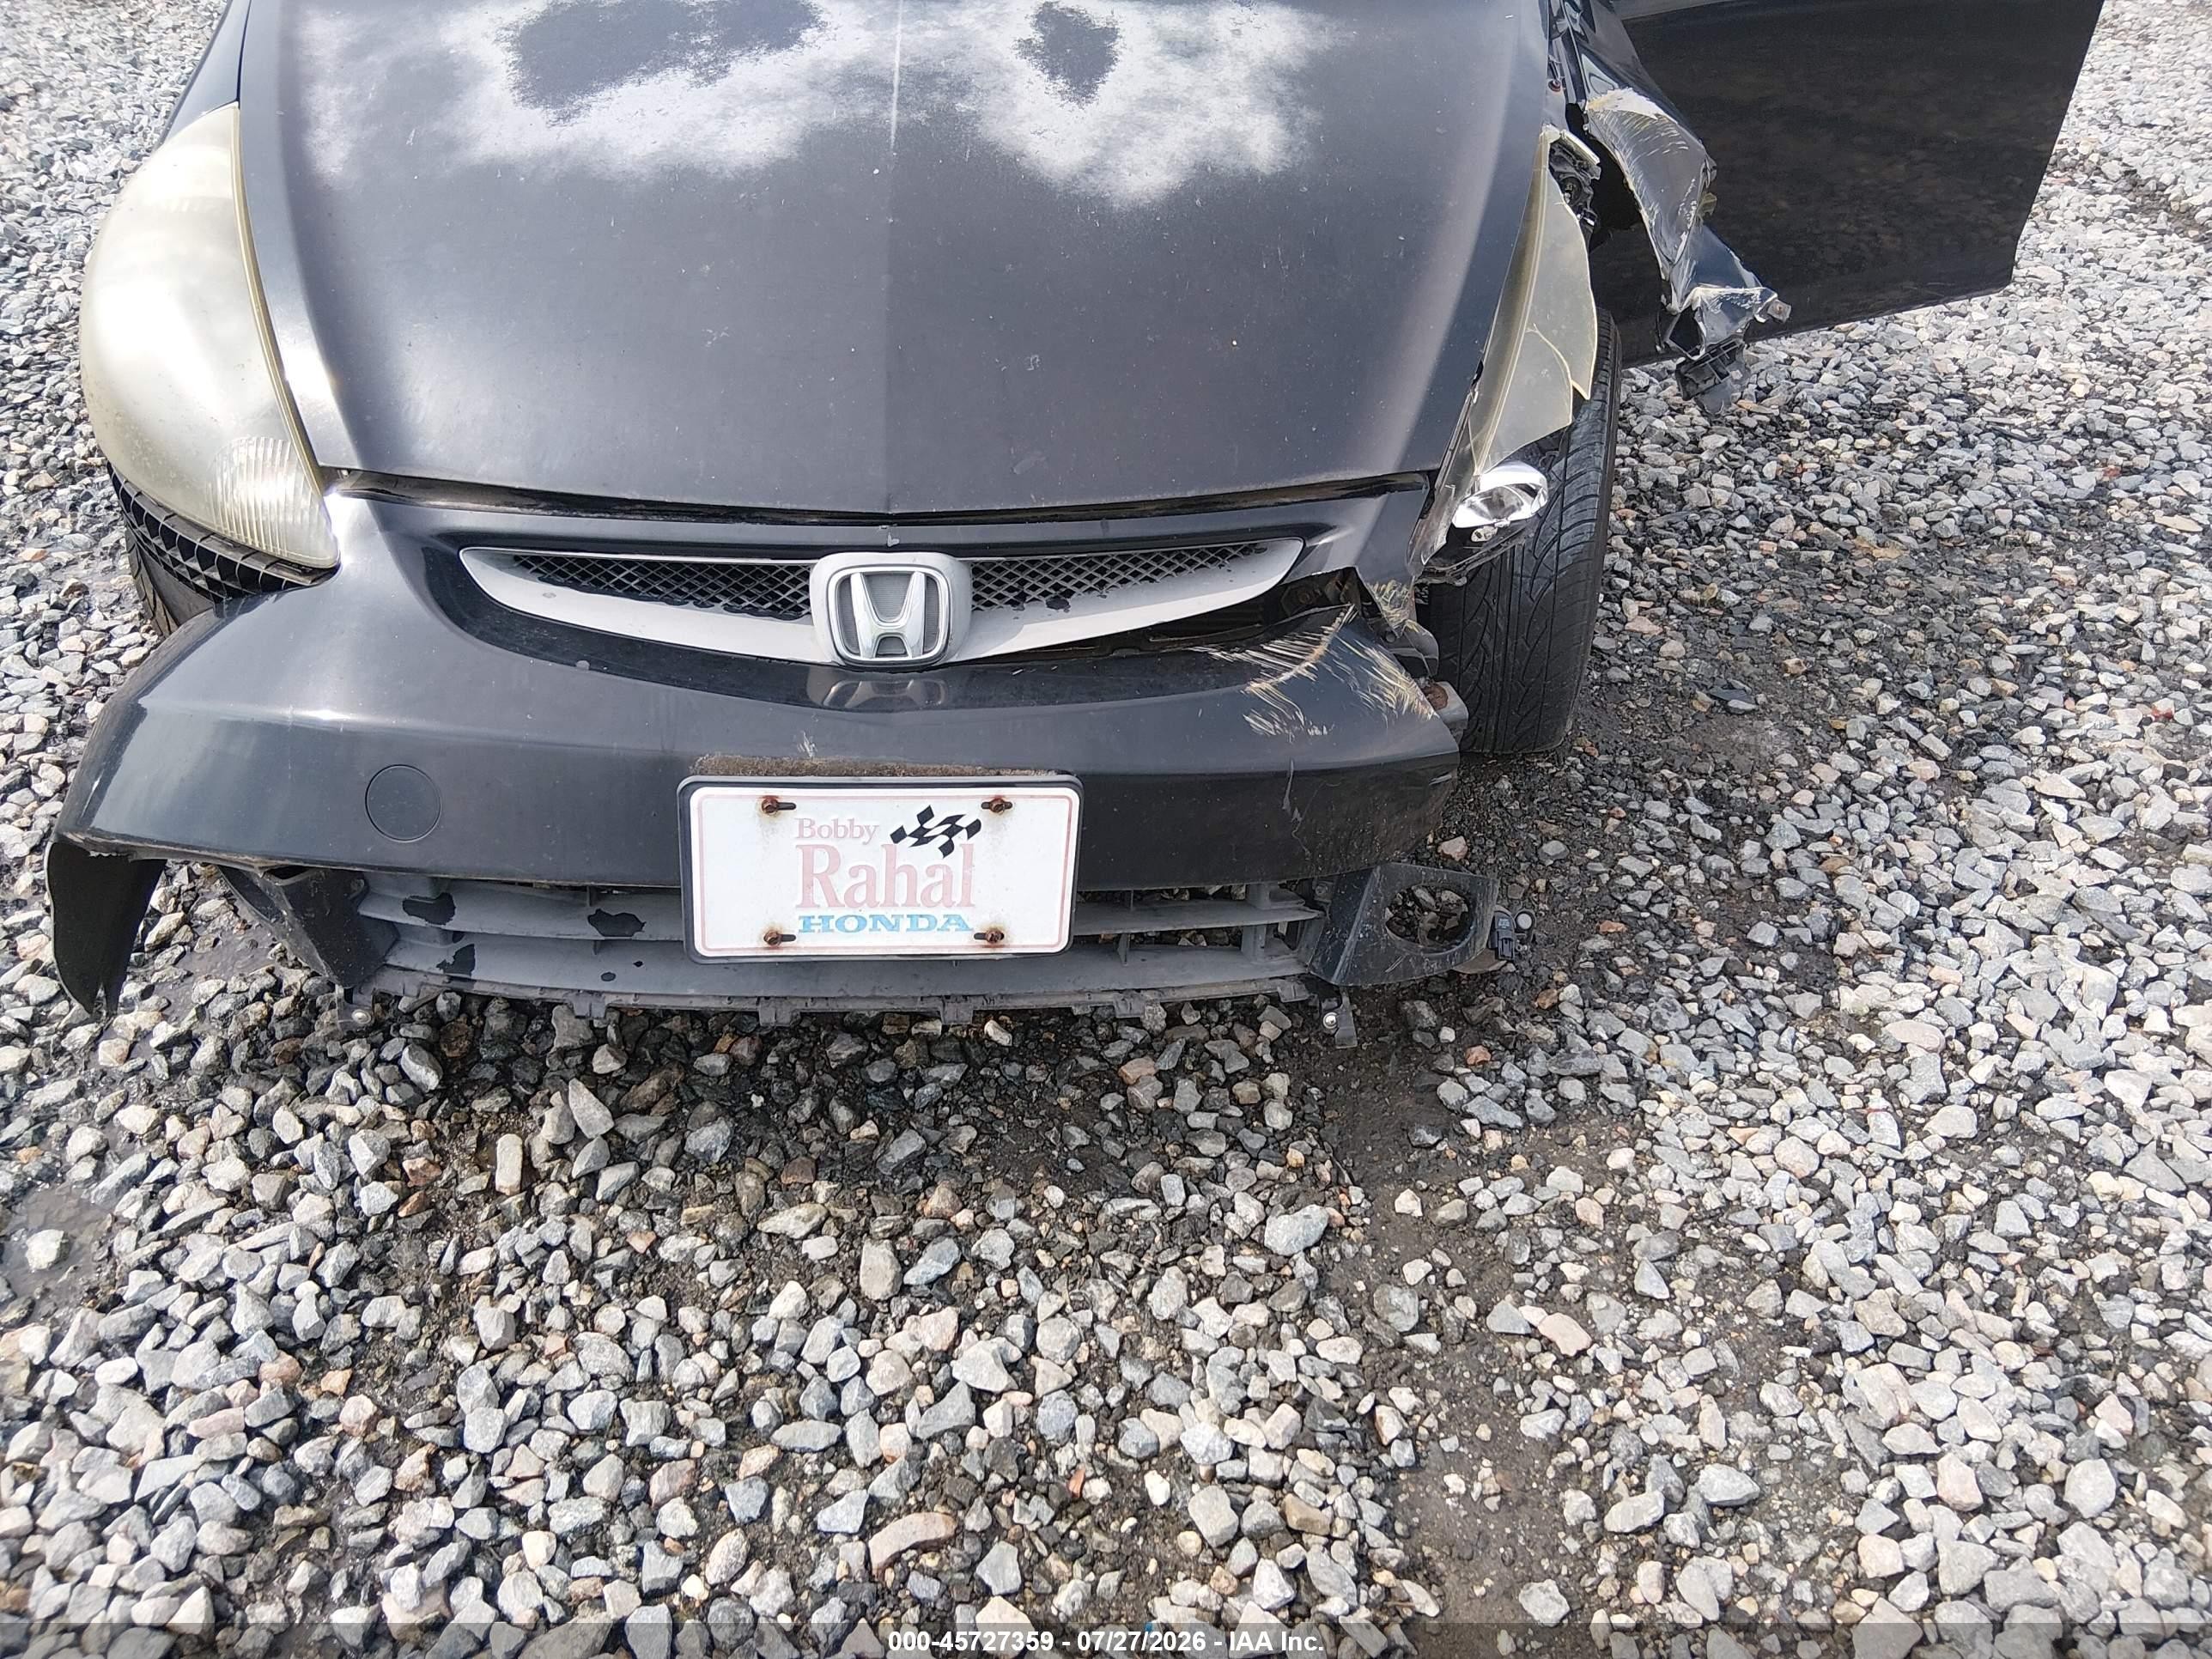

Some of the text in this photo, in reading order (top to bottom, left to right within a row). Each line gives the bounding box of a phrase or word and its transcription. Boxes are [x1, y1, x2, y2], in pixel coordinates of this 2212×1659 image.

[794, 817, 880, 845] Bobby
[795, 843, 975, 908] Rahal
[798, 914, 975, 933] HONDA
